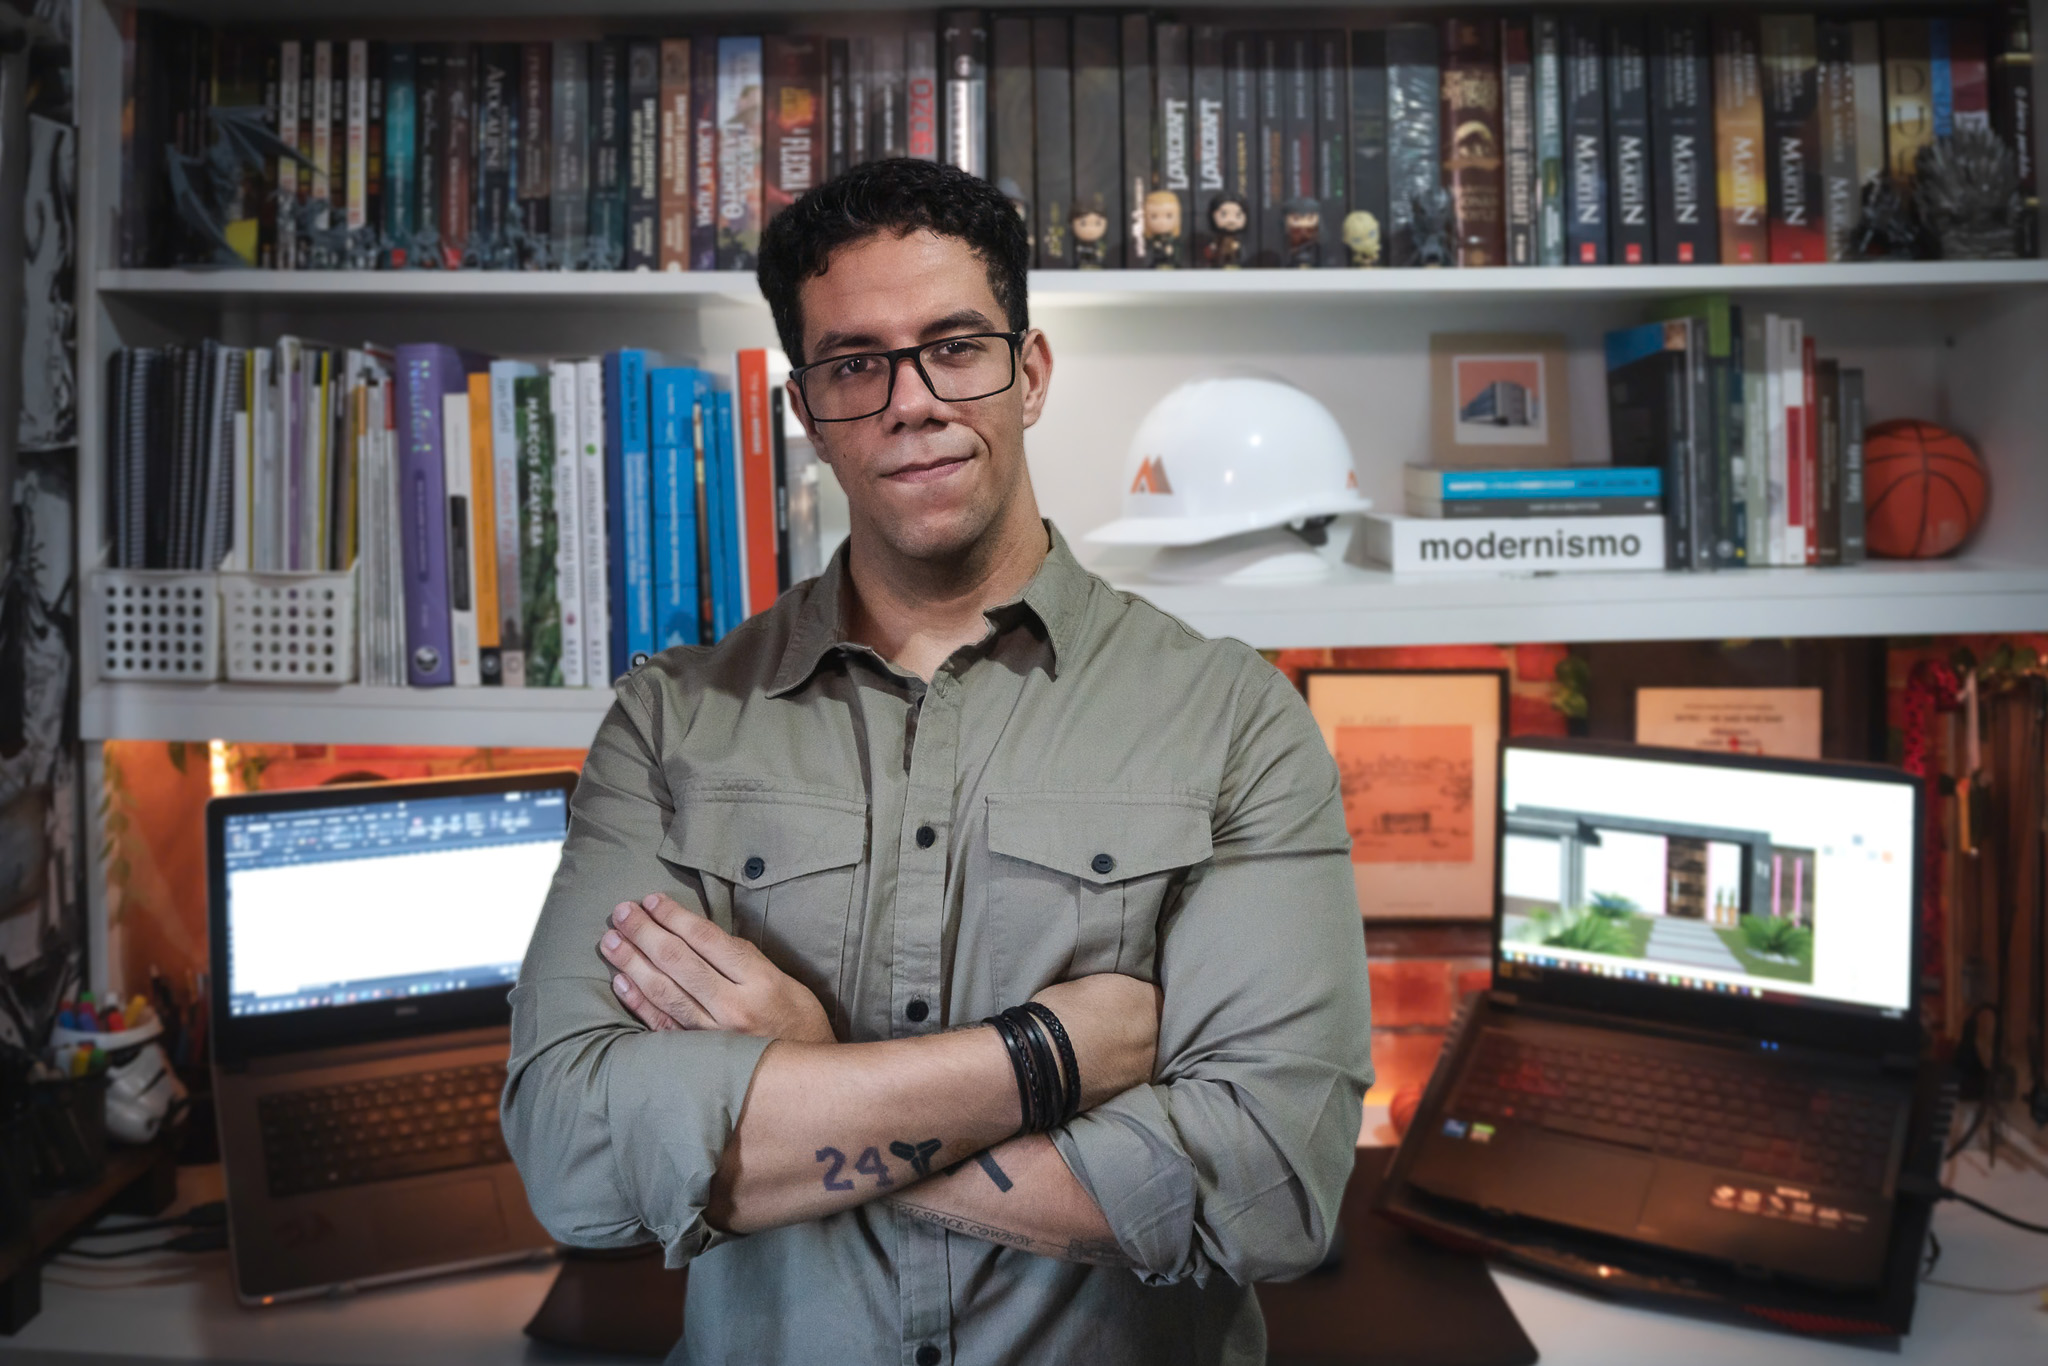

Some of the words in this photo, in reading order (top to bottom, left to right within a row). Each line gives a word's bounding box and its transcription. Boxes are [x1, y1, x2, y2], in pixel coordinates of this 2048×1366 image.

[1166, 98, 1188, 190] LOVECRAFT
[1200, 98, 1223, 190] LOVECRAFT
[1574, 134, 1600, 224] MARTIN
[1618, 135, 1646, 225] MARTIN
[1672, 134, 1699, 224] MARTIN
[1732, 136, 1758, 226] MARTIN
[1780, 136, 1807, 226] MARTIN
[1510, 152, 1529, 225] LOVECRAFT
[408, 359, 432, 453] Neufert
[525, 397, 541, 467] MARCOS
[499, 458, 514, 515] Cidades
[528, 471, 543, 547] ACAYABA
[501, 518, 516, 552] Para
[1420, 529, 1641, 561] modernismo
[816, 1146, 894, 1191] 24
[922, 1210, 965, 1230] SPACE
[968, 1224, 1036, 1248] COWBOY
